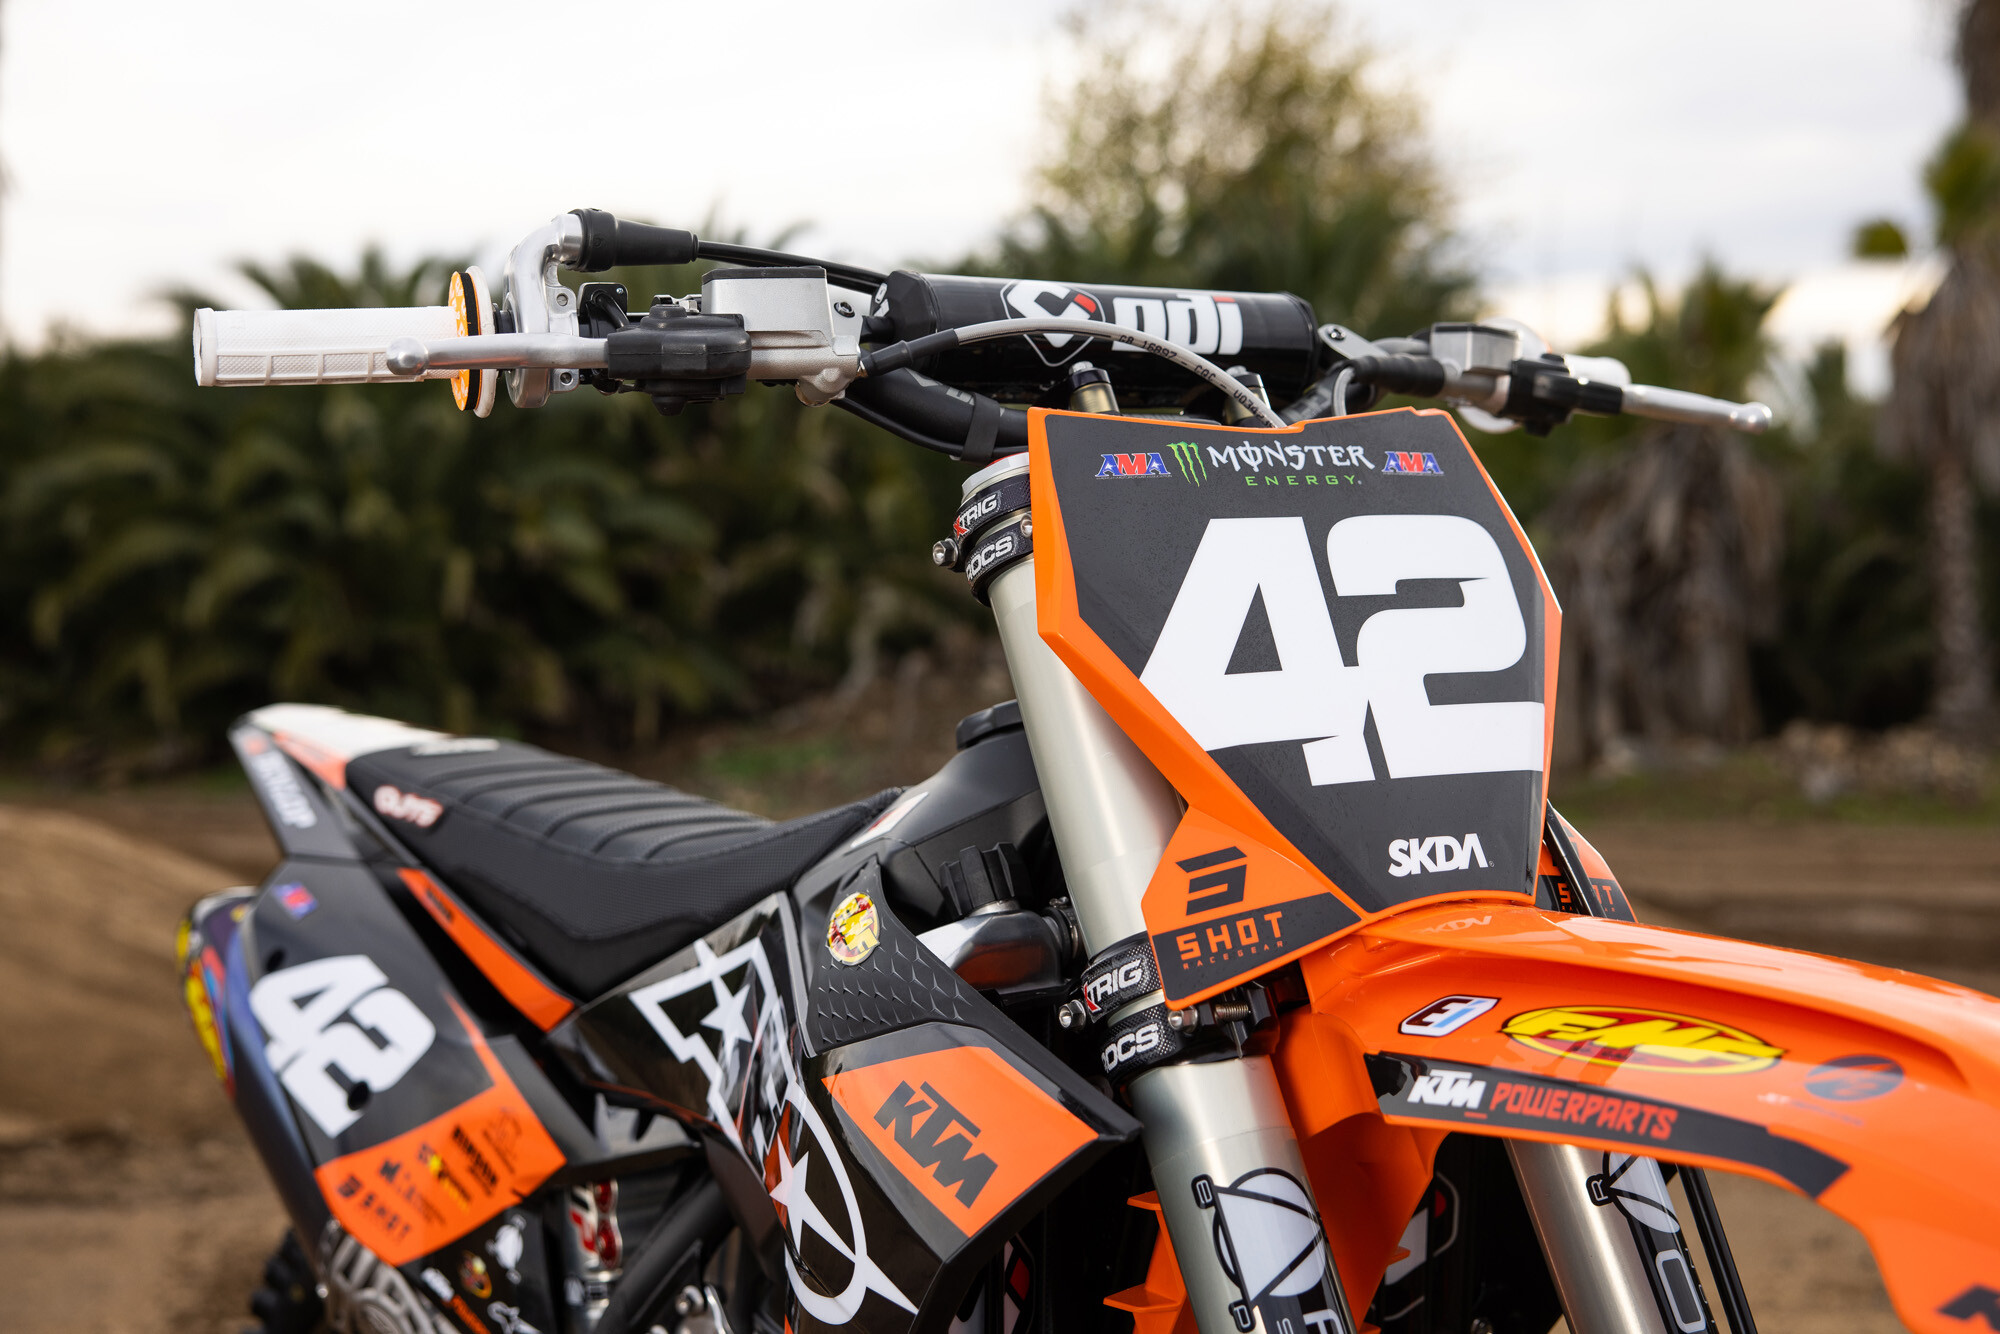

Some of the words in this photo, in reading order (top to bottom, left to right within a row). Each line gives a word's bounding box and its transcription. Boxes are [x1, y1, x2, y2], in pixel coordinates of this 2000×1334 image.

[1141, 340, 1178, 360] 16897
[1095, 452, 1171, 477] AMA
[1206, 440, 1376, 472] MONSTER
[1382, 451, 1444, 475] AMA
[953, 494, 998, 538] XTRIG
[1139, 514, 1546, 786] 42
[1388, 833, 1489, 877] SKDA
[1176, 911, 1283, 961] SHOT
[1183, 941, 1284, 970] RACEGEAR
[249, 954, 437, 1139] 42
[1500, 1010, 1787, 1063] FMF
[1407, 1069, 1487, 1109] KTM
[1489, 1081, 1678, 1141] POWERPARTS
[873, 1080, 999, 1209] KTM
